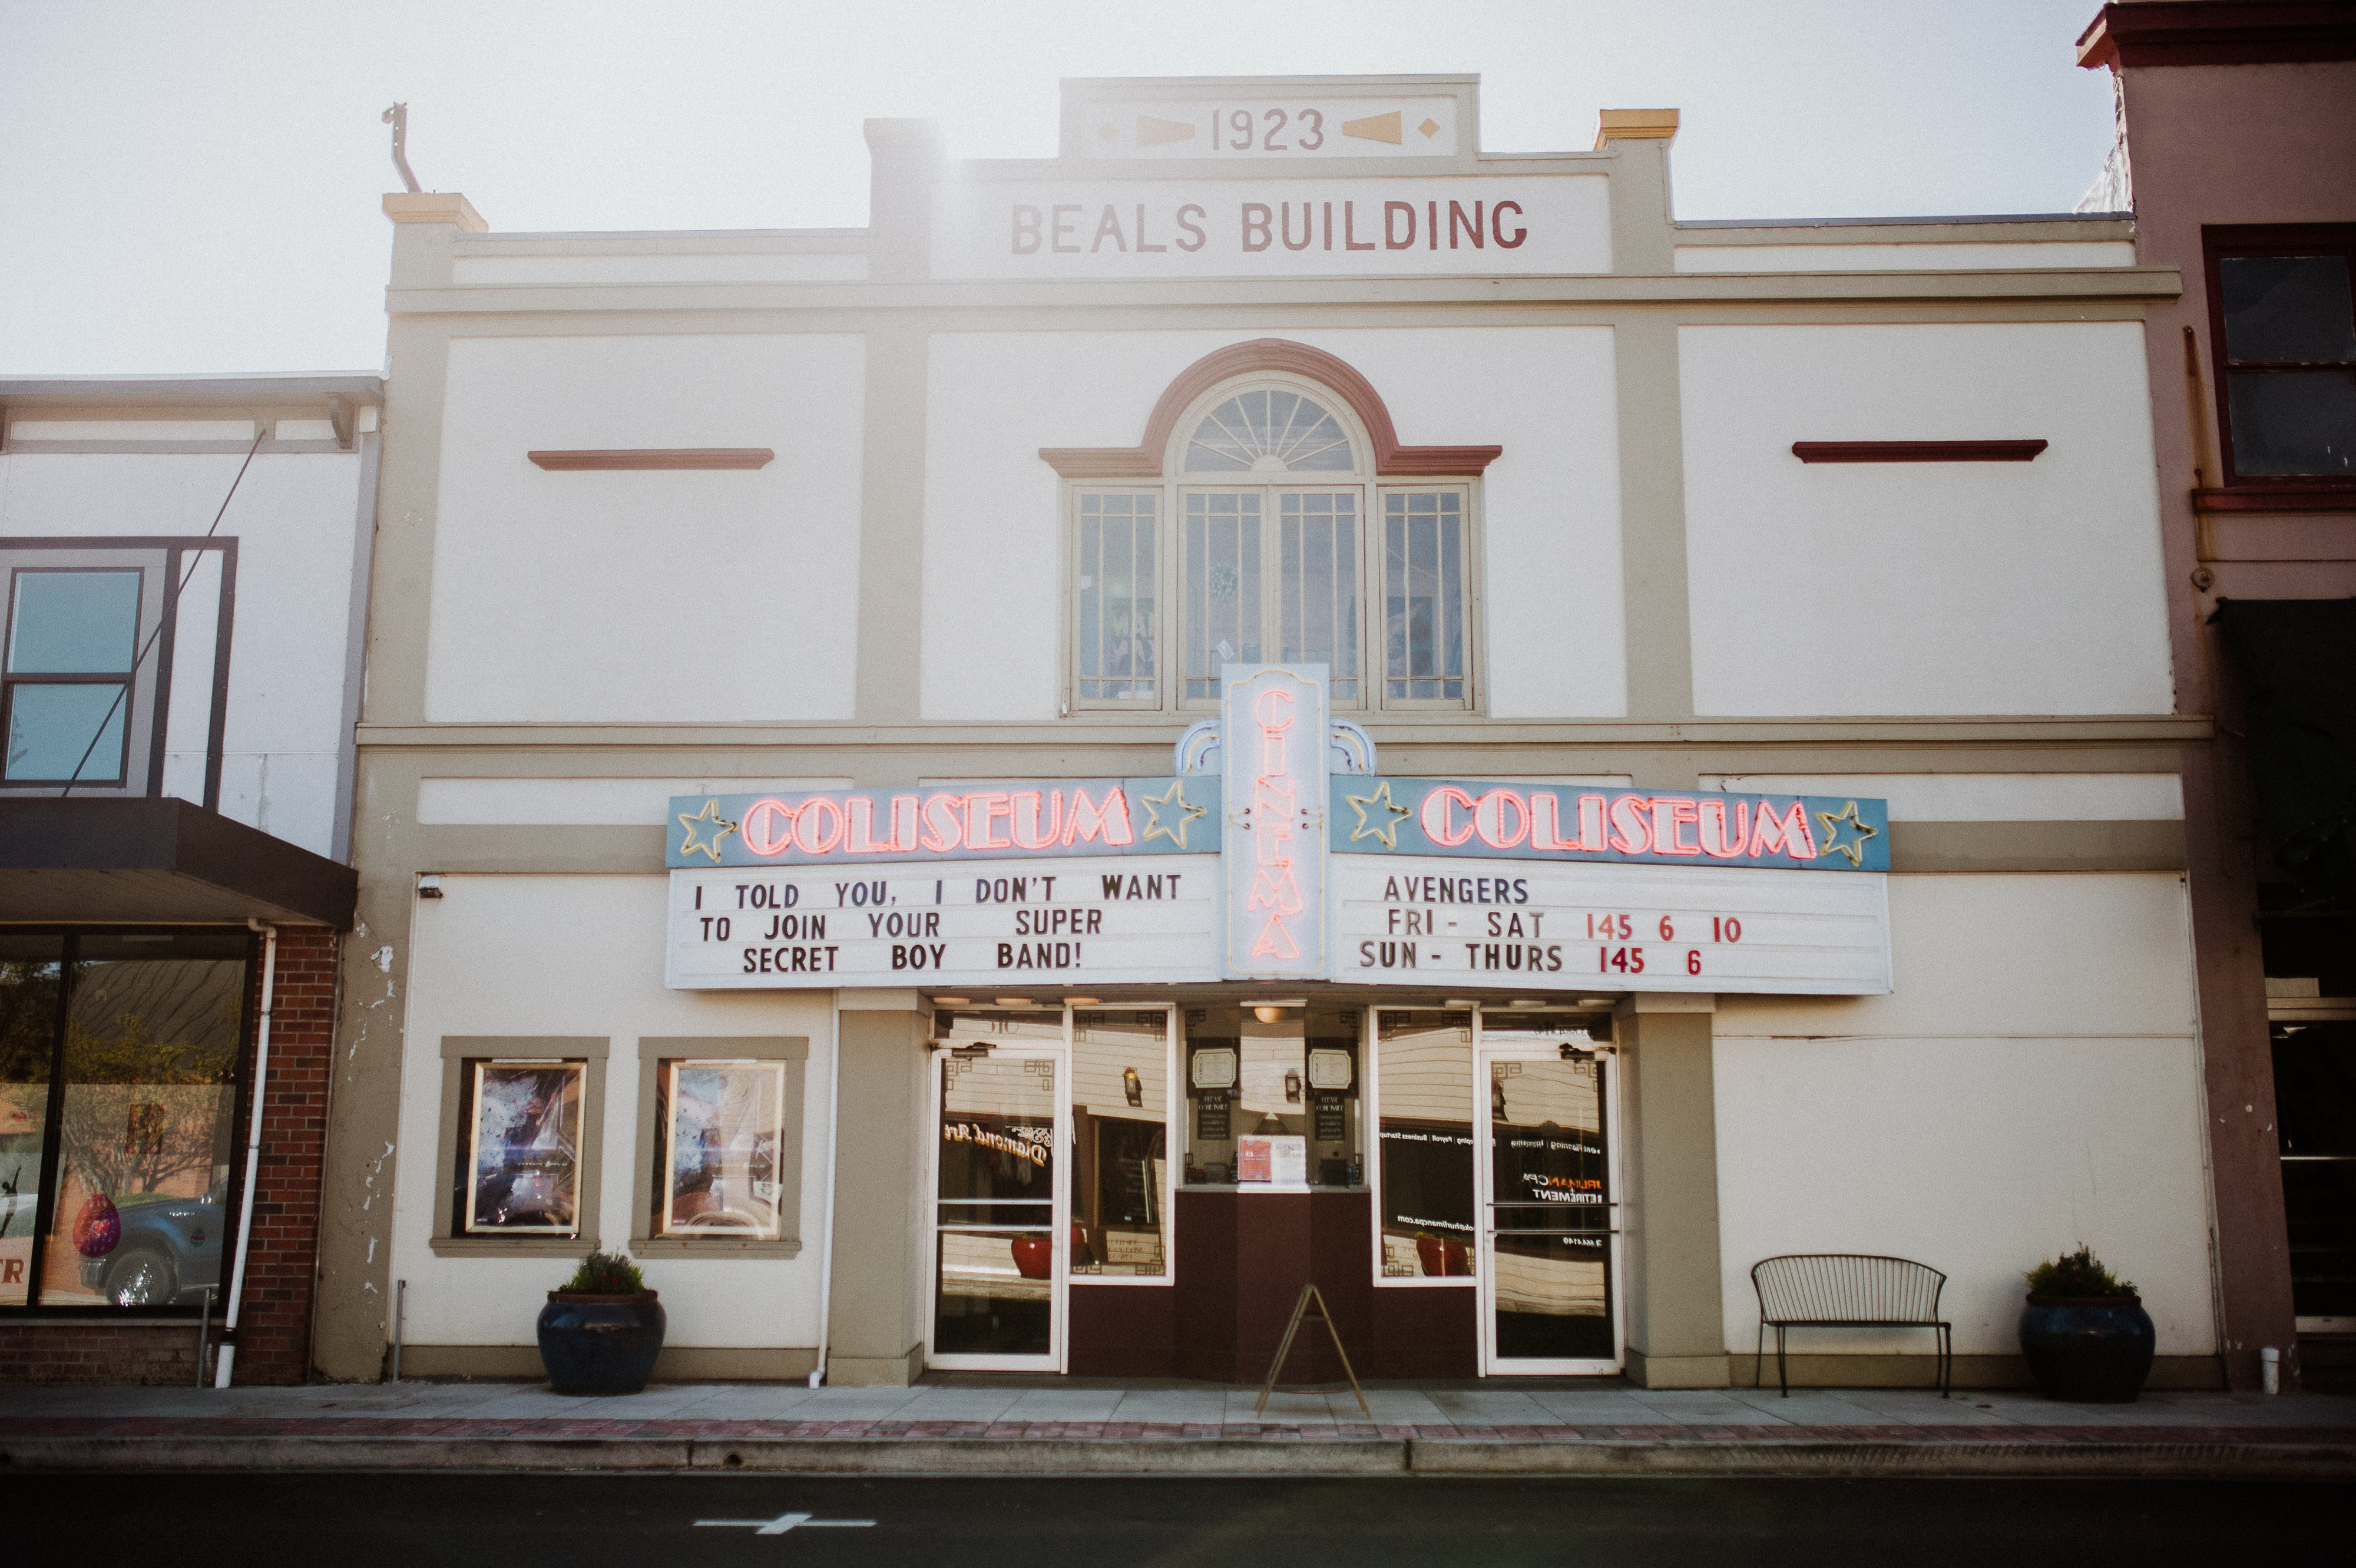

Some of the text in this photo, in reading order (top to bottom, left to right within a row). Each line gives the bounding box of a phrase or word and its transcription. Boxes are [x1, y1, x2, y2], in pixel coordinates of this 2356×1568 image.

[1213, 108, 1325, 152] 1923
[1011, 200, 1529, 256] BEALS BUILDING
[742, 786, 1136, 857] COLISEUM
[1248, 690, 1303, 959] CINEMA
[1419, 786, 1818, 861] COLISEUM
[695, 874, 1182, 911] I TOLD YOU, I DON'T WANT
[1384, 876, 1530, 906] AVENGERS
[700, 909, 1103, 942] TO JOIN YOUR SUPER
[1488, 912, 1545, 939] SAT
[1587, 914, 1633, 941] 145
[1659, 915, 1675, 943] 6
[1713, 917, 1743, 944] 10
[743, 942, 1082, 975] SECRET BOY BAND!
[1465, 943, 1563, 973] THURS
[1600, 947, 1646, 975] 145
[1687, 950, 1702, 977] 6
